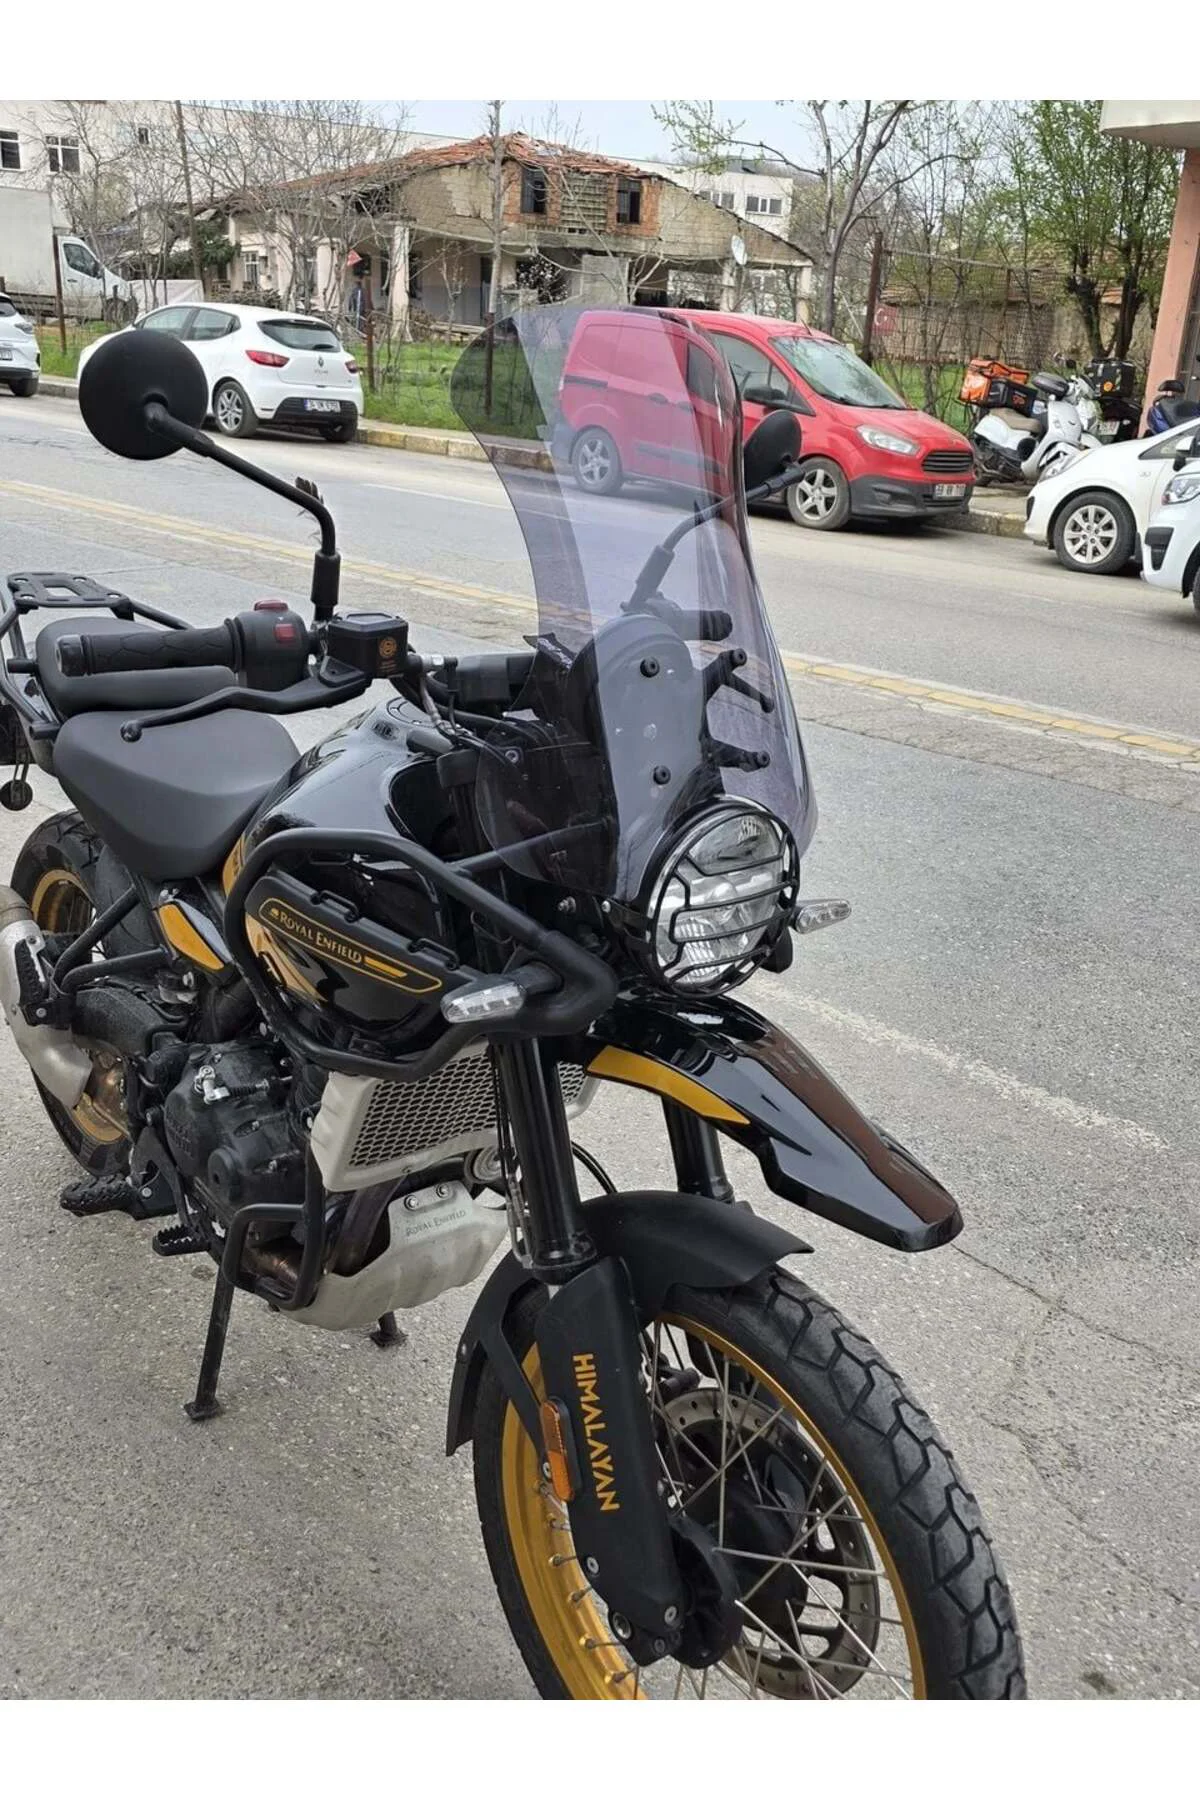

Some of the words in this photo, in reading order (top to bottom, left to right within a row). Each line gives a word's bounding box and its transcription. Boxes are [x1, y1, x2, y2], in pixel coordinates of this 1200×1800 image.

[280, 911, 313, 940] ROYAL
[315, 931, 362, 963] ENFIELD
[573, 1353, 620, 1511] HIMALAYAN
